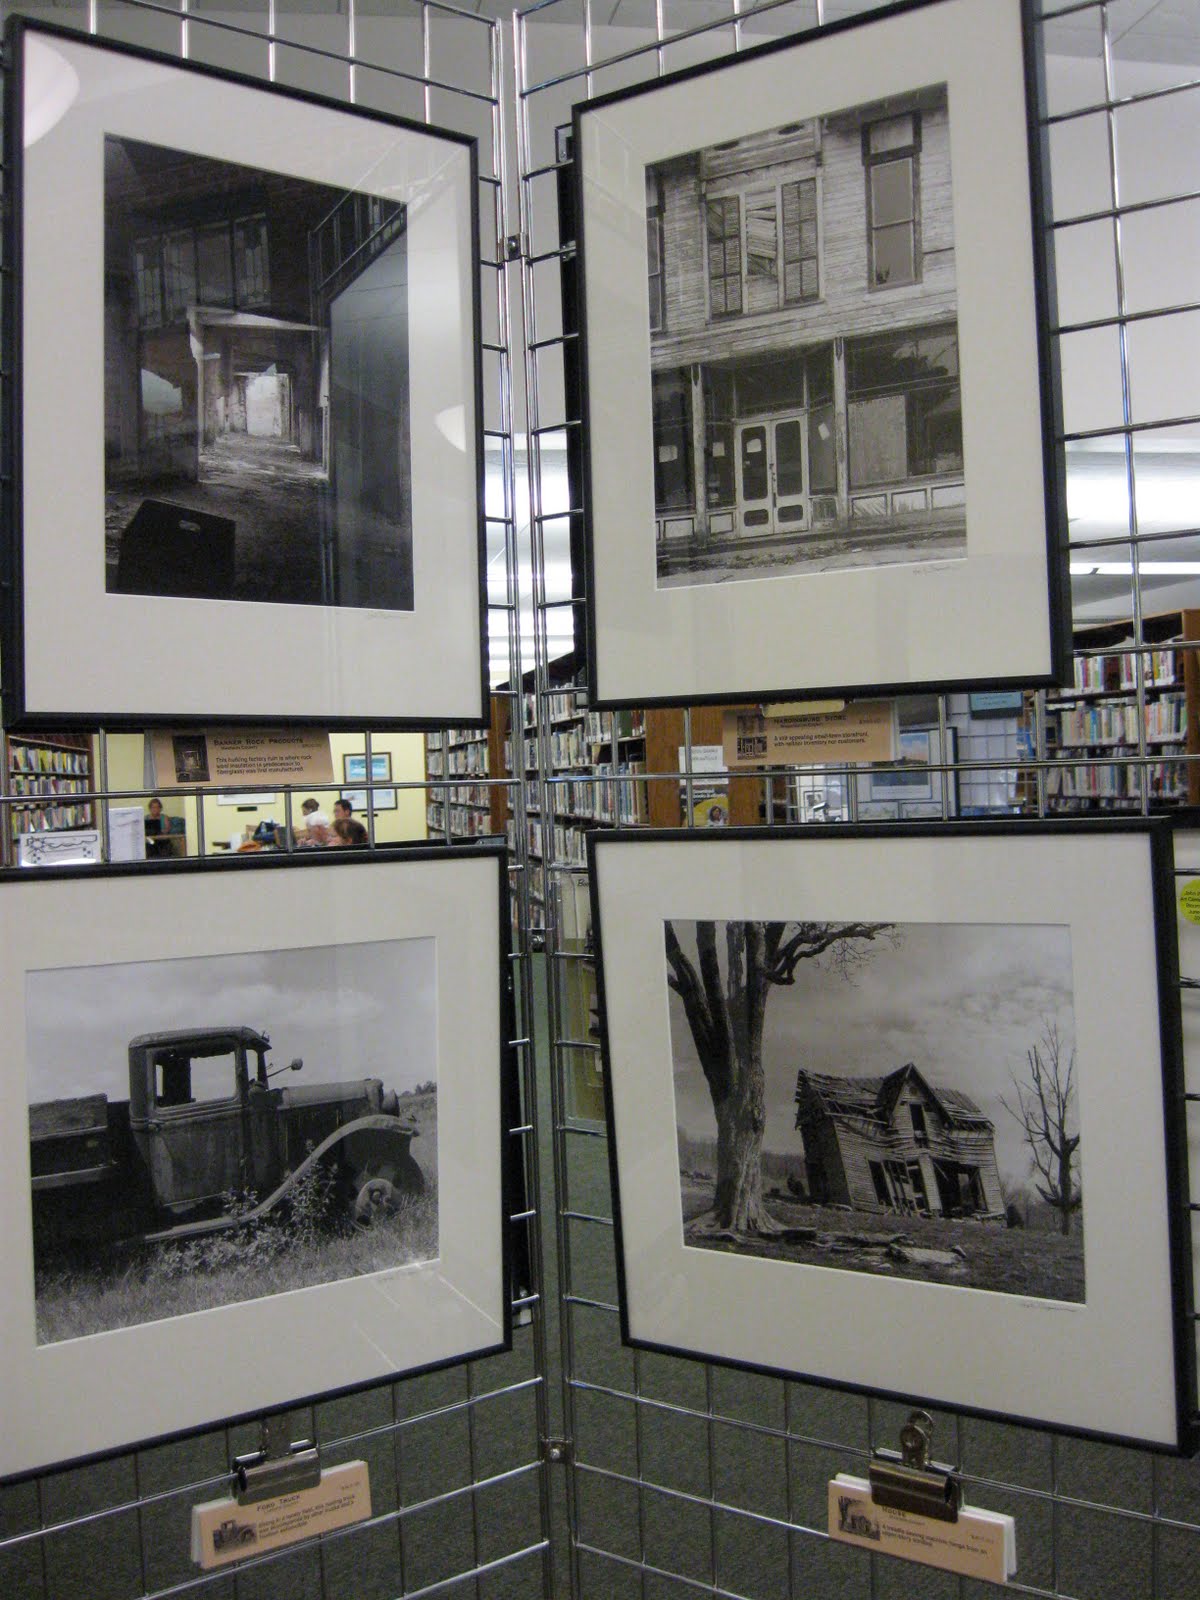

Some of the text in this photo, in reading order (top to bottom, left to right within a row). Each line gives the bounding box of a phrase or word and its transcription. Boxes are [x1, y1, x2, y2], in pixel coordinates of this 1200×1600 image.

[257, 1501, 275, 1511] FORD
[280, 1495, 300, 1504] TRUCK
[882, 1506, 906, 1517] HOUSE
